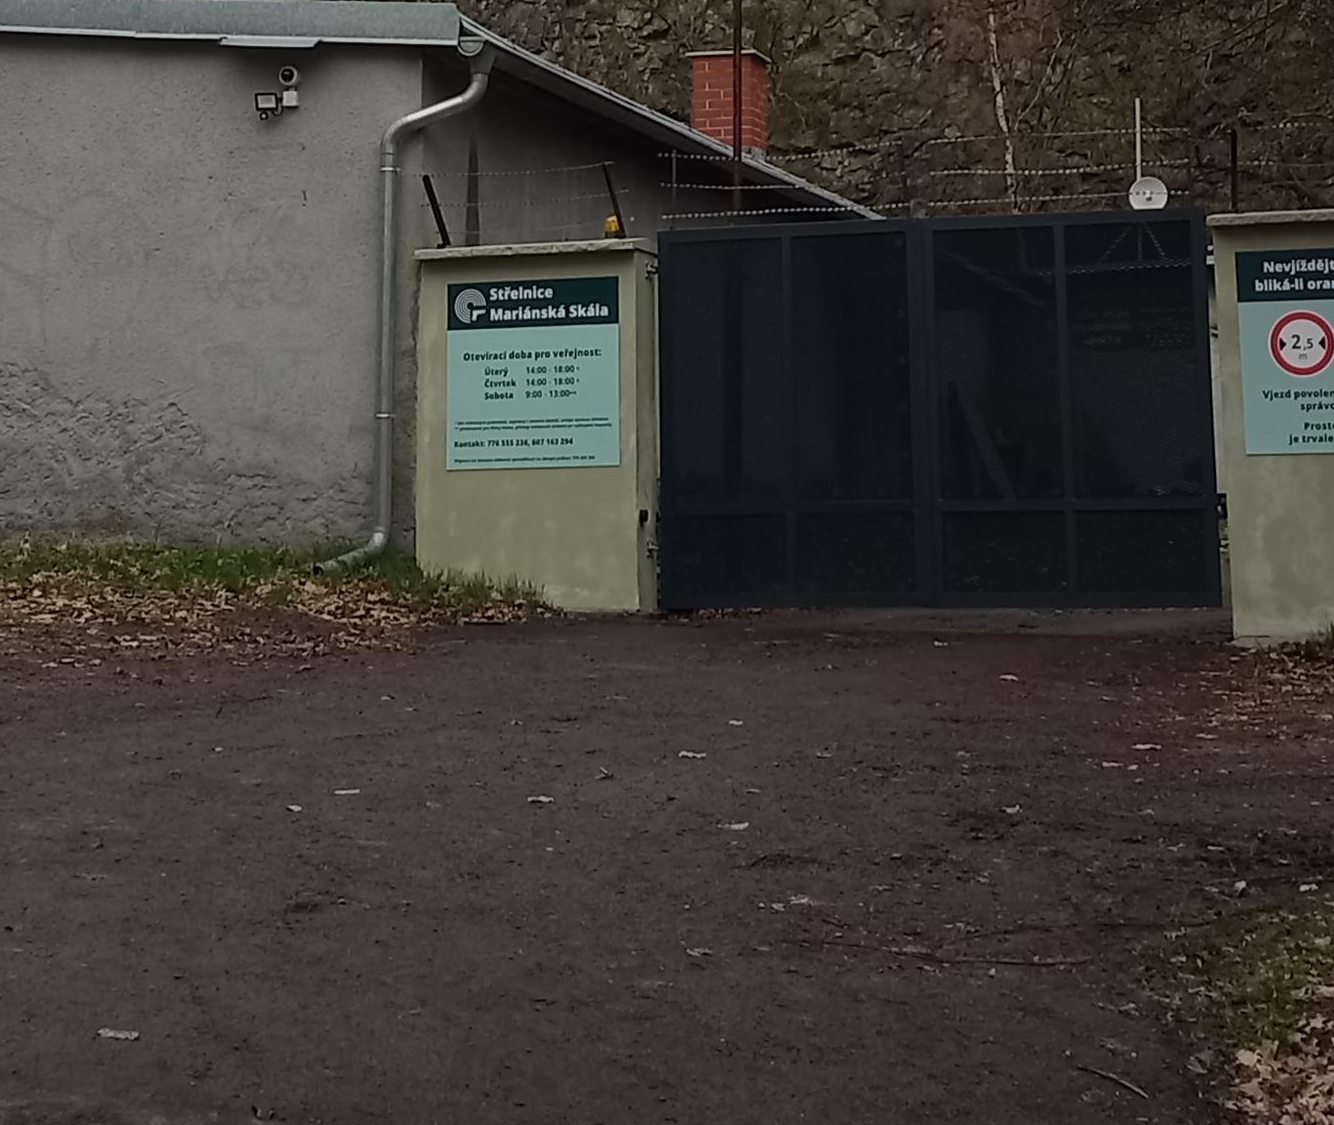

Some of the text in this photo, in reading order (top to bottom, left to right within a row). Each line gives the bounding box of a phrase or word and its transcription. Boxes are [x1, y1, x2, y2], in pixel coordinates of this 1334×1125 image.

[1255, 278, 1304, 292] bliká-li
[489, 286, 553, 301] Střelnice
[490, 303, 609, 321] Mariánská Skála
[1291, 334, 1314, 350] 2,5
[509, 350, 532, 360] doba
[534, 350, 551, 361] pro
[553, 348, 602, 360] veřejnost:
[484, 366, 509, 377] Úterý
[484, 378, 517, 388] Čtvrtek
[484, 391, 514, 400] Sobota
[525, 390, 543, 398] 9:00
[1262, 389, 1292, 401] Vjezd
[454, 439, 485, 448] Kontakt:
[1289, 434, 1299, 445] je
[1302, 433, 1334, 443] trvale
